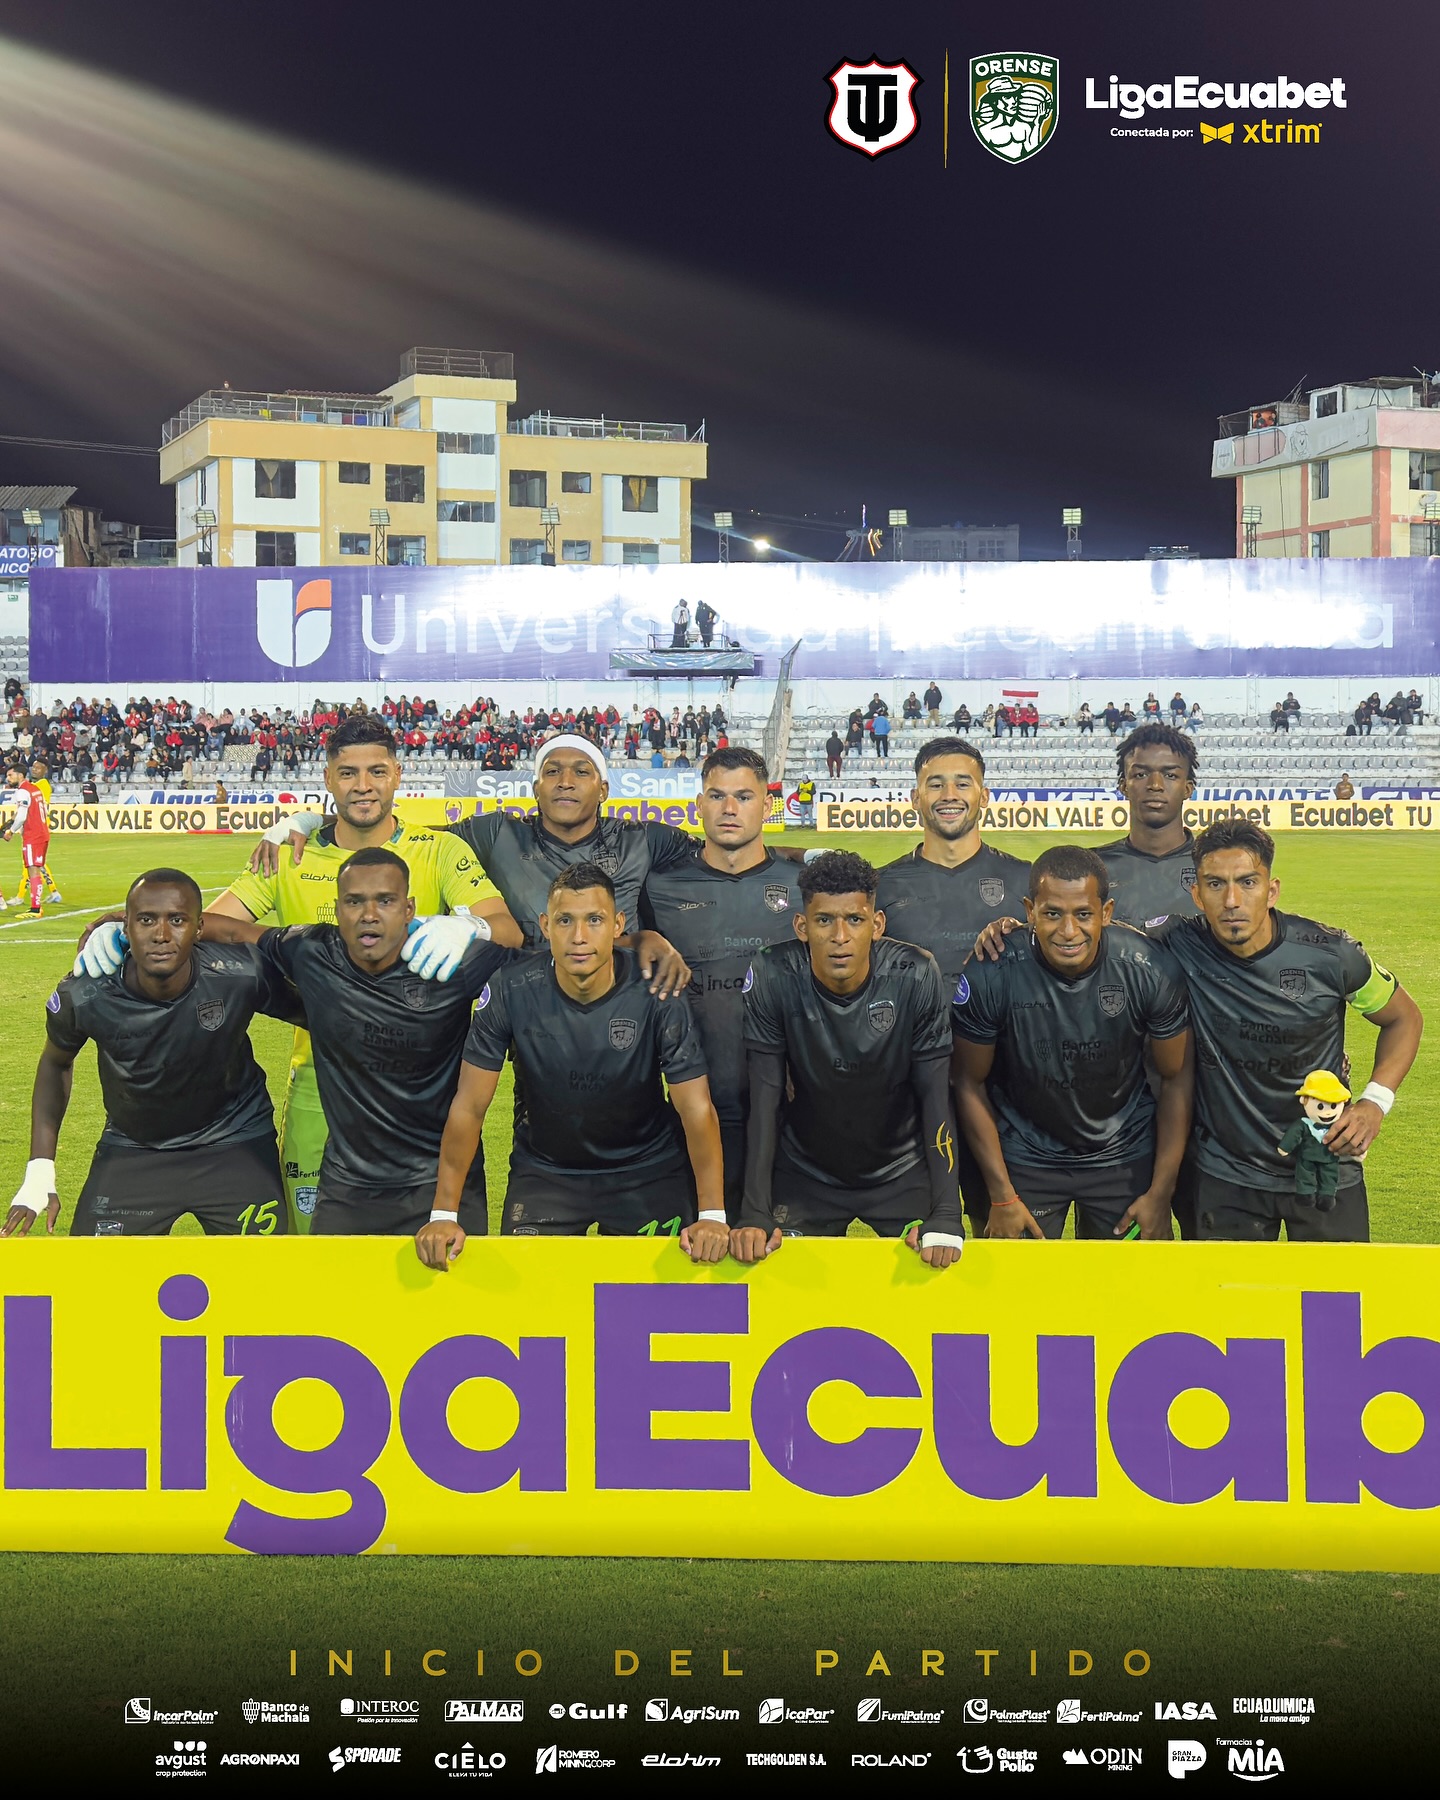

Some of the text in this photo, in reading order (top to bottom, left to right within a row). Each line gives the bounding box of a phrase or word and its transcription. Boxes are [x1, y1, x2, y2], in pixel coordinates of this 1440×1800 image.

[48, 804, 99, 830] SIÓN
[106, 809, 152, 830] VALE
[159, 809, 206, 830] ORO
[216, 806, 311, 830] Ecuab
[978, 801, 1048, 828] ASIÓN
[1055, 807, 1103, 827] VALE
[1183, 802, 1432, 827] cuabet Ecuabet TU
[724, 935, 762, 947] Banco
[364, 1022, 405, 1036] Banco
[1240, 1017, 1281, 1034] Banco
[236, 1200, 279, 1236] 15
[4, 1274, 1440, 1556] LigaEcuab
